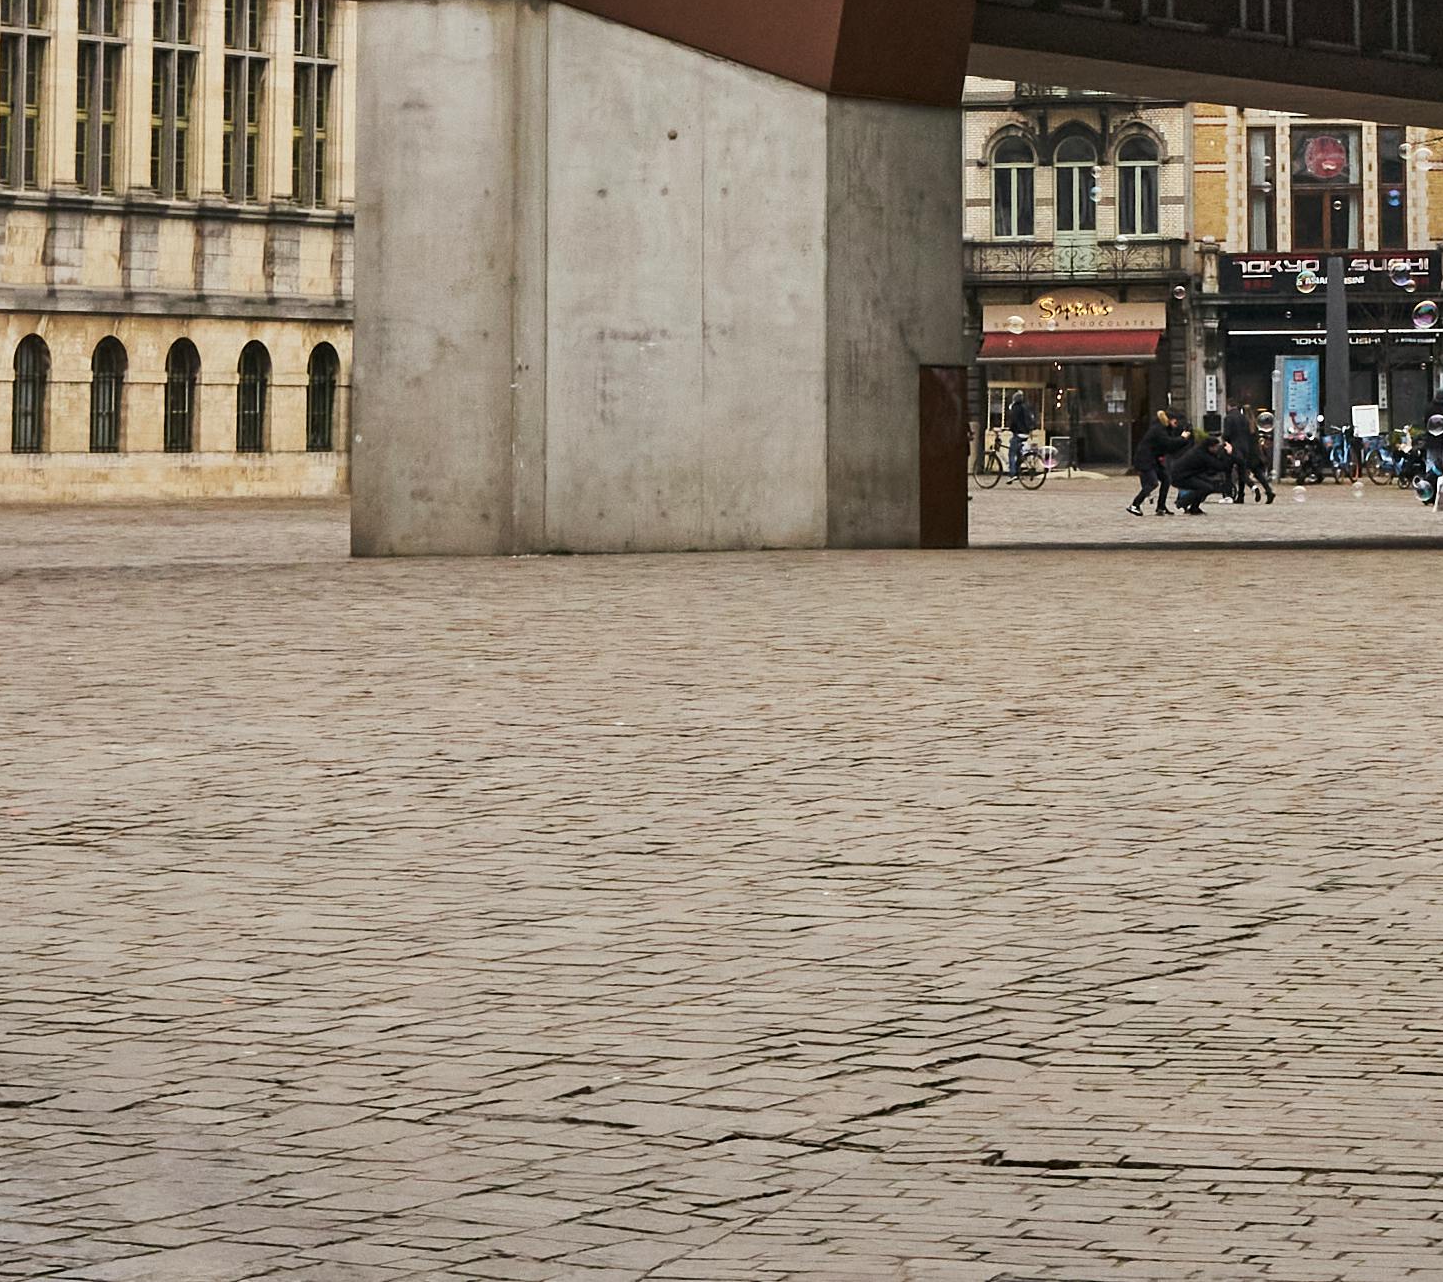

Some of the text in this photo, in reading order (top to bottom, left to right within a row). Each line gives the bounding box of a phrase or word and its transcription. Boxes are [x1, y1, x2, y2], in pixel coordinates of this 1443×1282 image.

[1233, 257, 1429, 274] TOKYO SUSHI
[1071, 319, 1155, 328] CHOCOLATES
[1291, 337, 1380, 345] TOKY USHI
